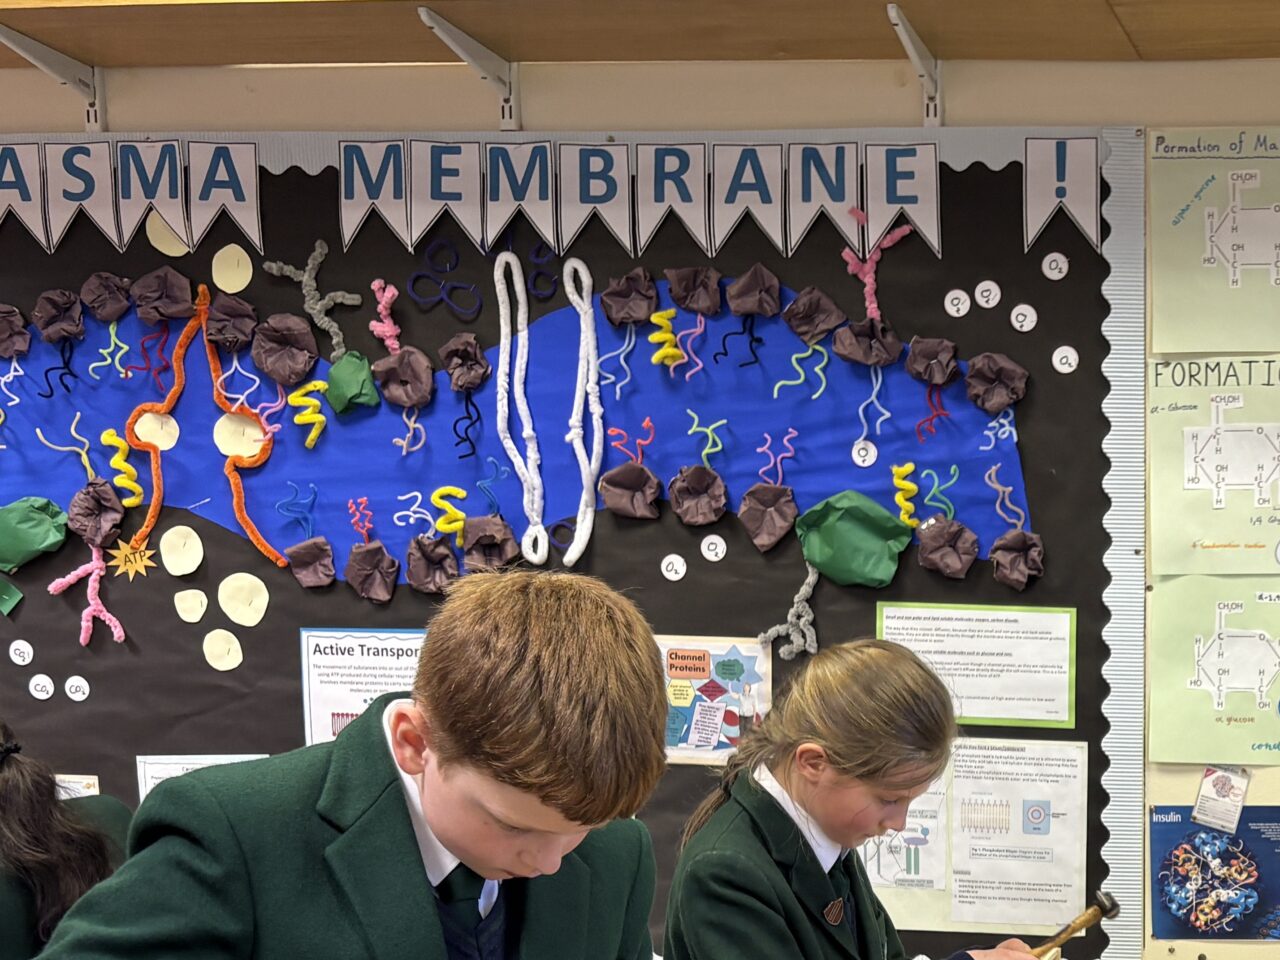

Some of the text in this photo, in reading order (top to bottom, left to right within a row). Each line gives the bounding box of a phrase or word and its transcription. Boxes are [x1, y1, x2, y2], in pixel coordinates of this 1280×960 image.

[1155, 137, 1219, 153] Formation
[1230, 132, 1246, 153] of
[344, 143, 919, 205] MEMBRANE
[122, 548, 150, 569] ATP
[313, 643, 419, 660] Active Transpor
[669, 652, 705, 662] Channel
[669, 664, 705, 673] Proteins
[1153, 813, 1181, 823] Insulin
